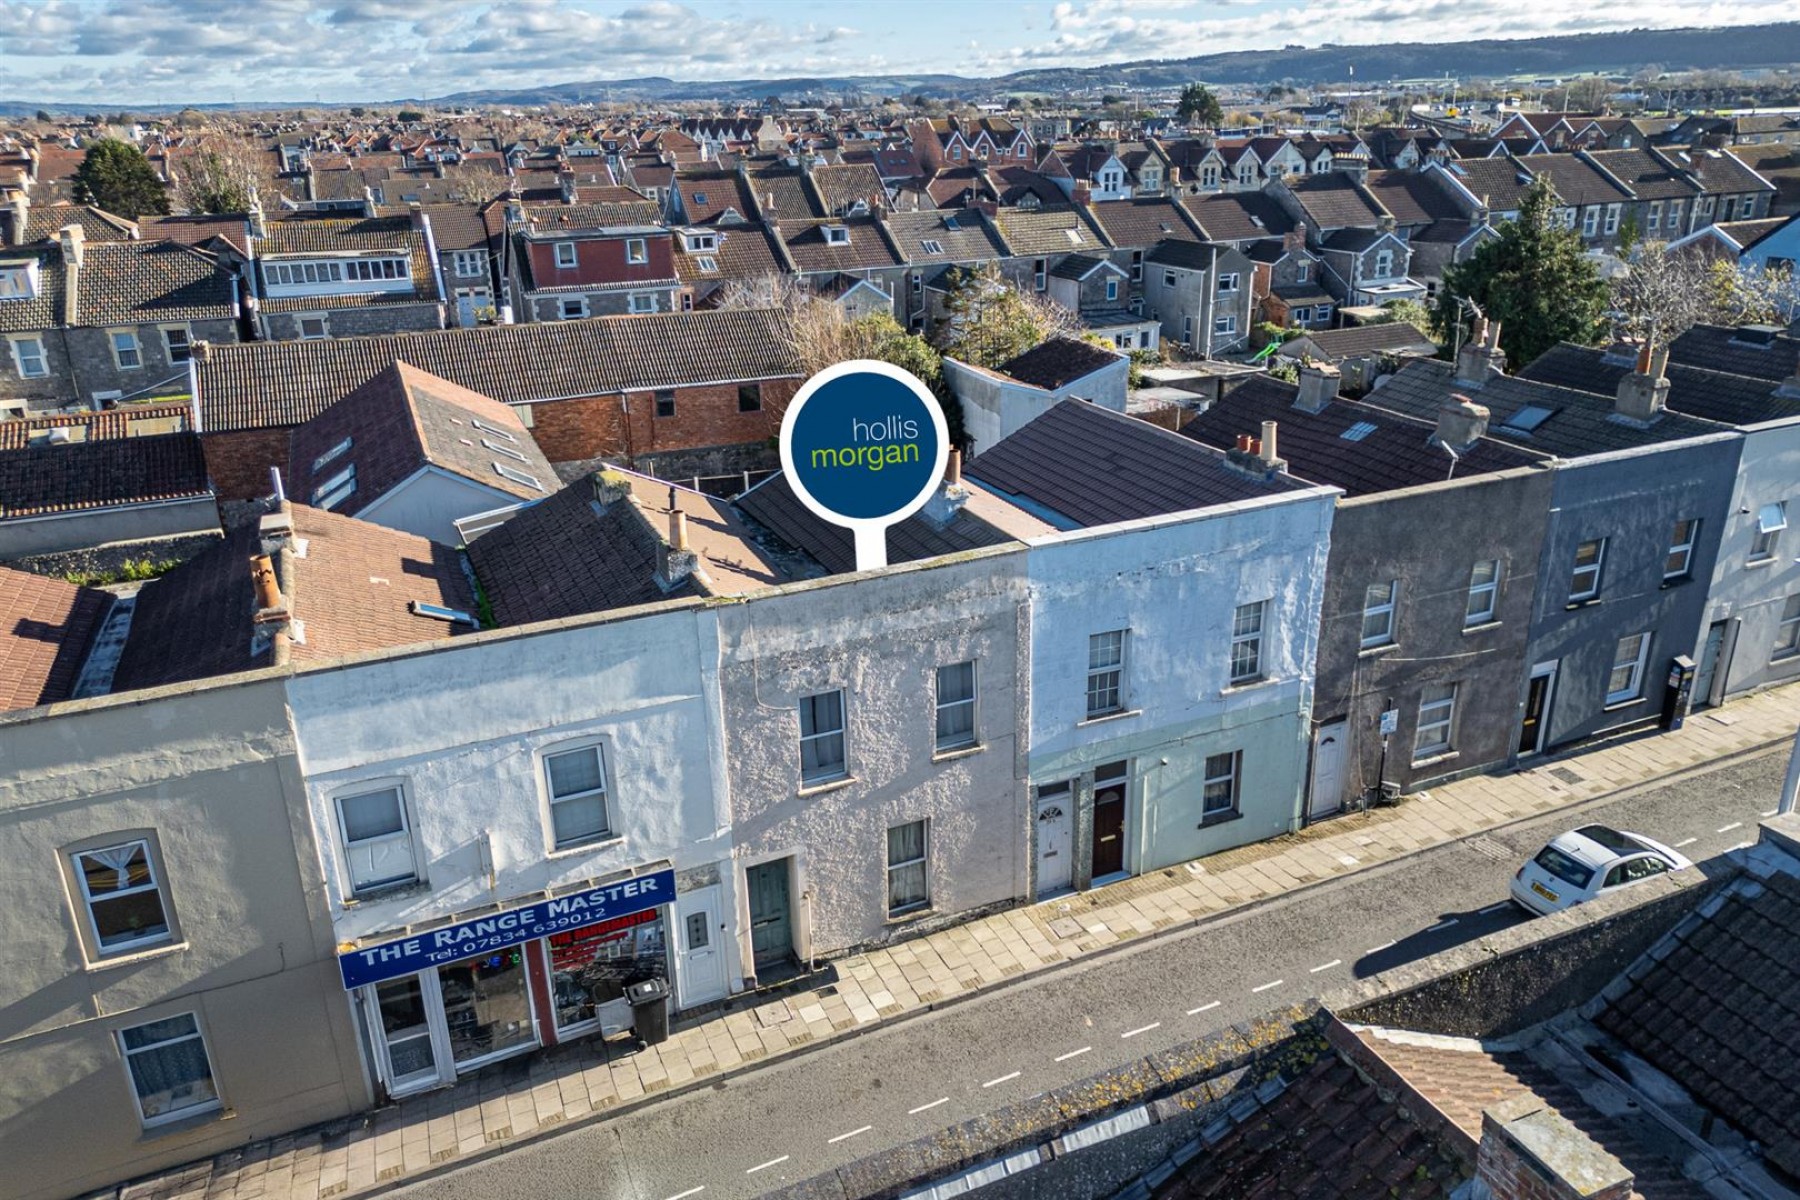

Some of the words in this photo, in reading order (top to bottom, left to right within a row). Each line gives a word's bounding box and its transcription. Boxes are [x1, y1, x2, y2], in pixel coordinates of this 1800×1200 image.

[360, 939, 421, 966] THE
[434, 909, 536, 948] RANGE
[548, 878, 658, 918] MASTER
[426, 948, 458, 962] Tel:
[463, 929, 527, 952] 07834
[533, 908, 606, 934] 639012
